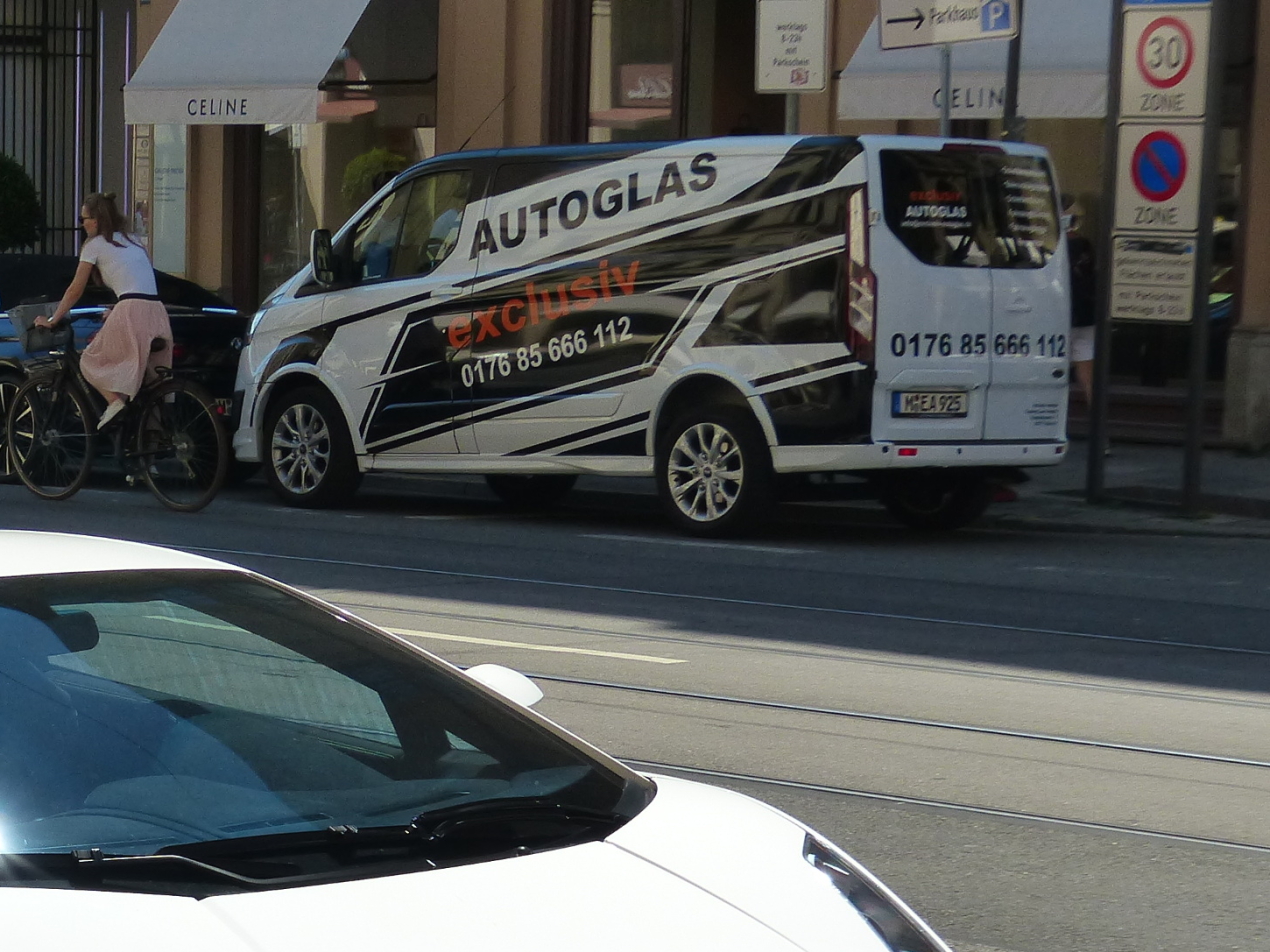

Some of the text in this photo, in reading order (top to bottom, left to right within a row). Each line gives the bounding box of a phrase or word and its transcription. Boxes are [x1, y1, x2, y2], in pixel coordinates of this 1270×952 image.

[1149, 35, 1182, 70] 30
[187, 98, 248, 116] CELINE
[932, 87, 1018, 109] CELIN
[1140, 92, 1185, 112] ZONE
[468, 152, 718, 261] AUTOGLAS
[905, 204, 968, 219] AUTOGLAS
[1134, 206, 1178, 225] ZONE
[447, 259, 641, 350] exclusiv
[460, 315, 633, 388] 0176 85 666 112
[890, 332, 1066, 358] 0176 85 666 112
